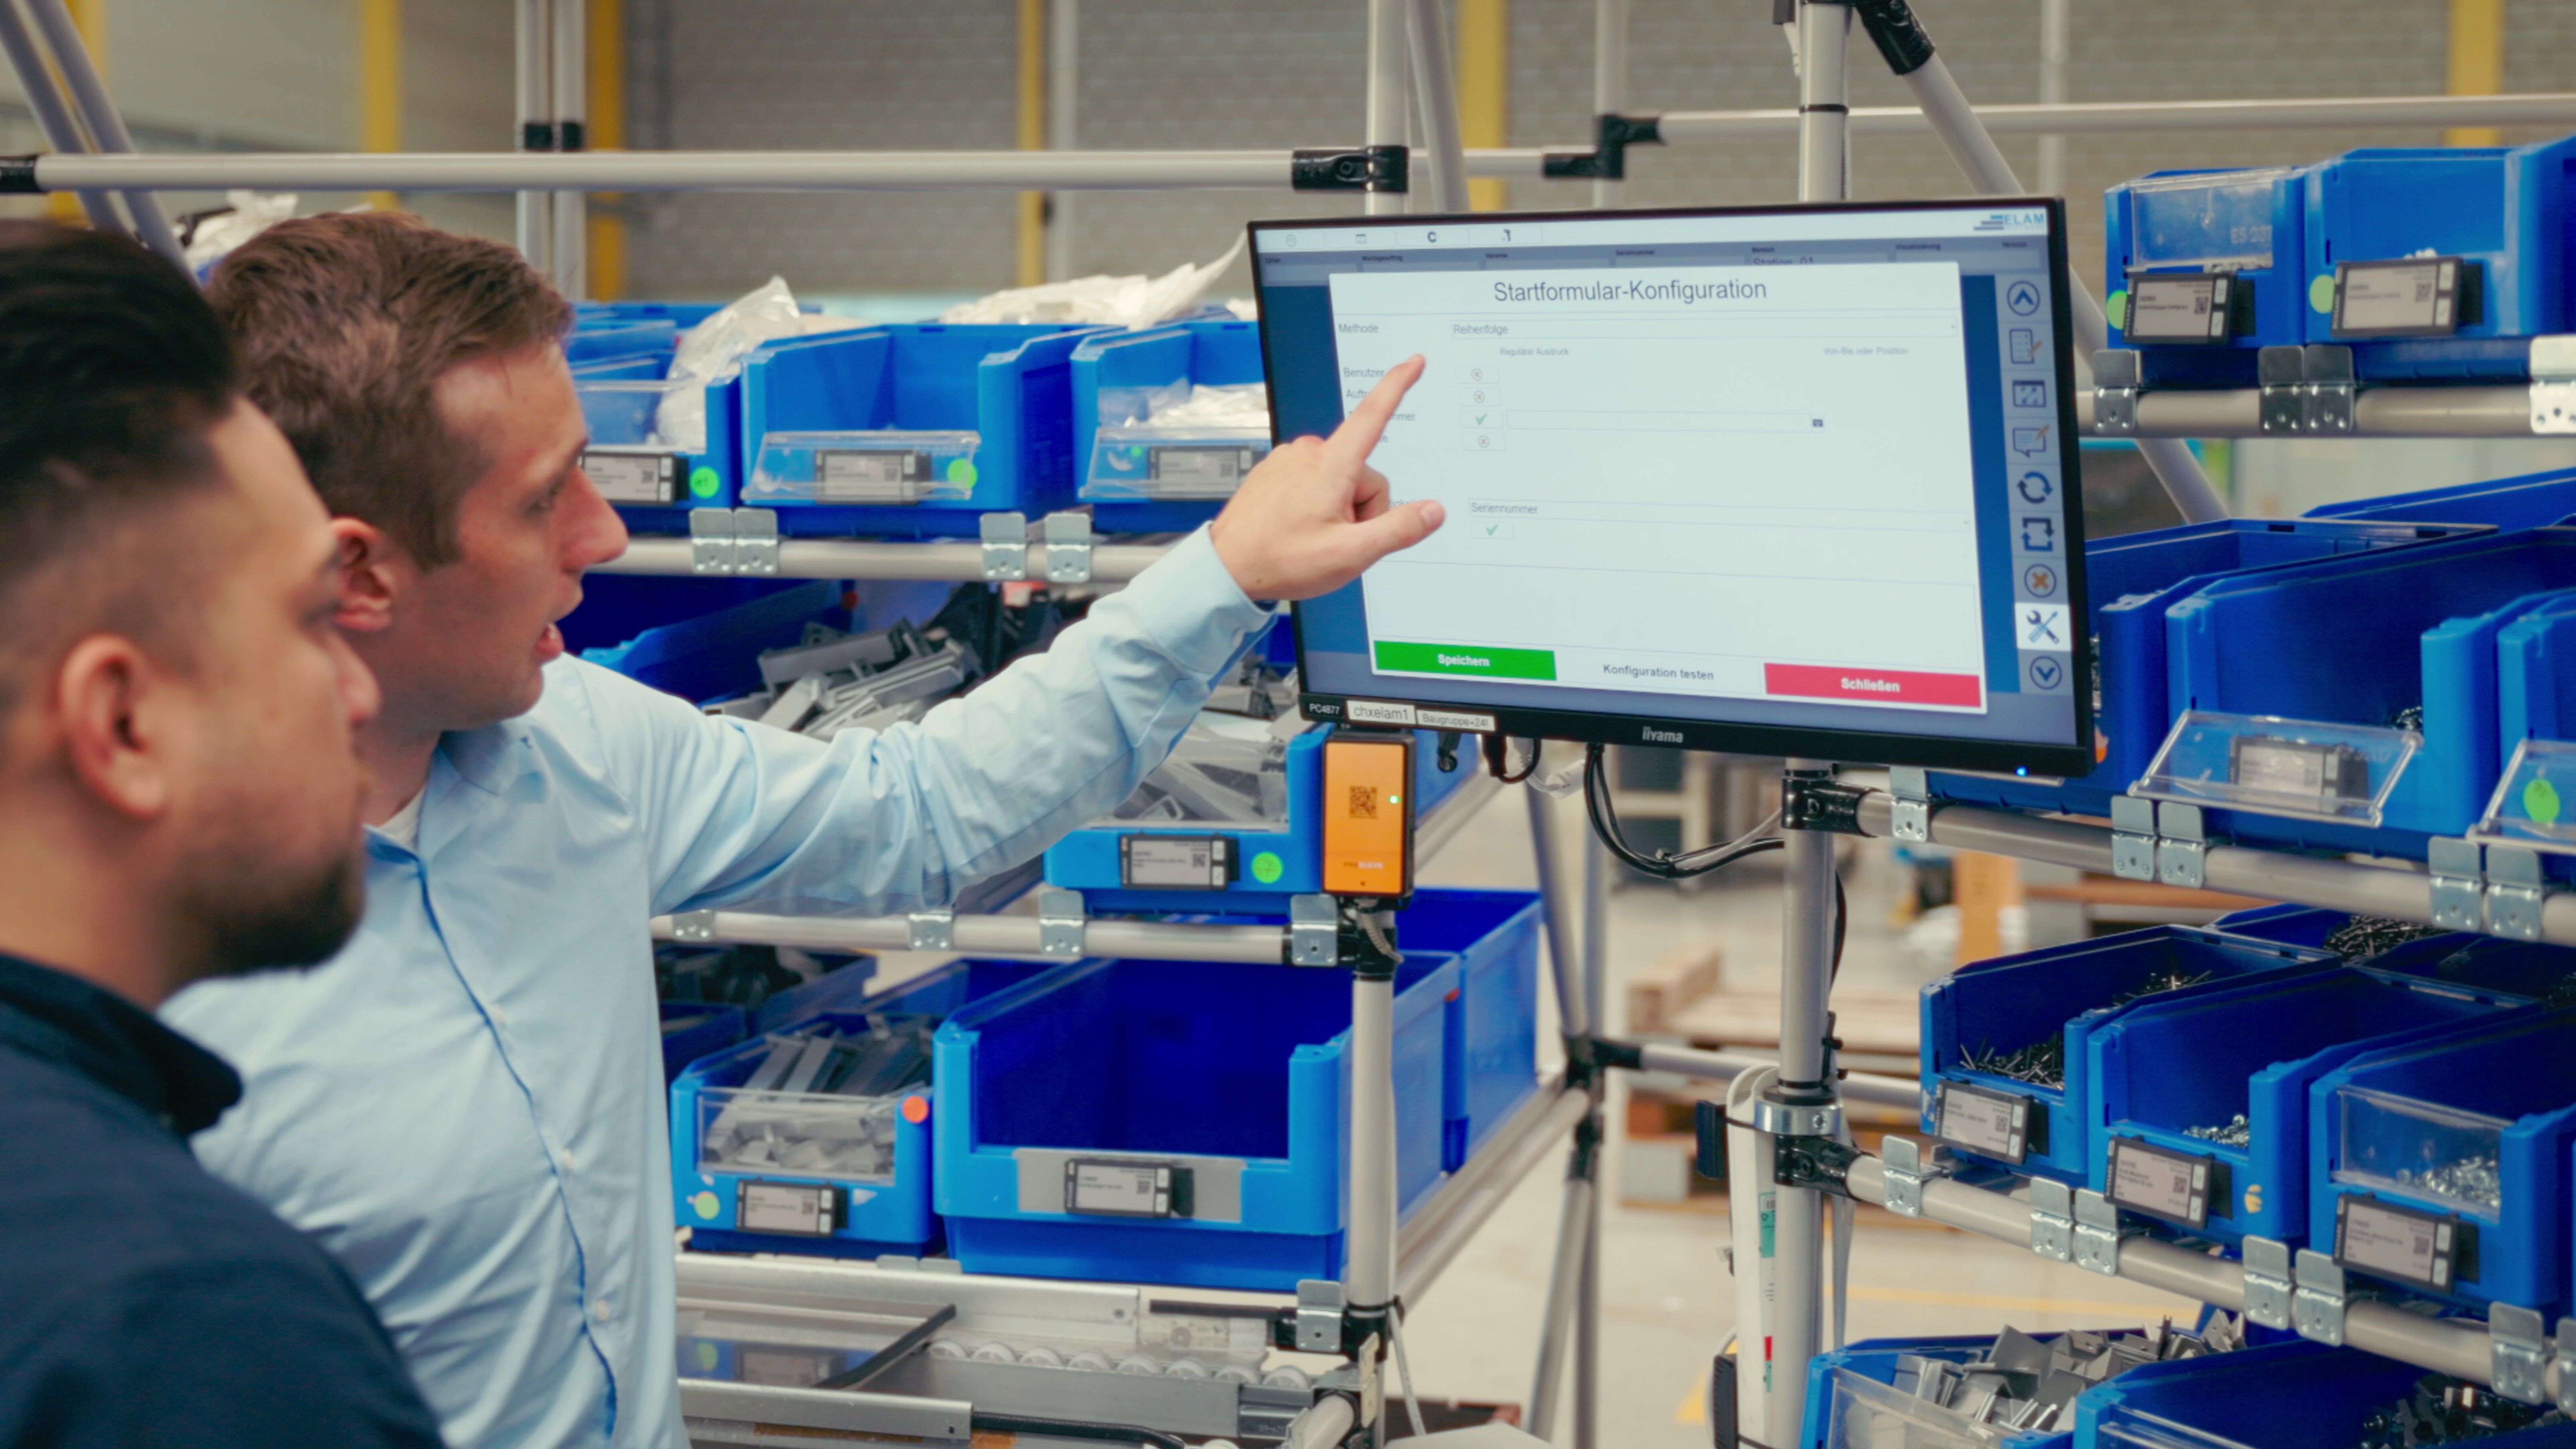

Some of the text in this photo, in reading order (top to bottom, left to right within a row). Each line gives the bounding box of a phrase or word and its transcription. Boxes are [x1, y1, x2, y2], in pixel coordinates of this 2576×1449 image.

[2004, 214, 2045, 225] ELAM
[1493, 278, 1768, 305] Startformular-Konfiguration
[1338, 323, 1379, 334] Methode
[1453, 324, 1509, 336] Reihenfolge
[1499, 347, 1534, 357] Regulärer
[1823, 346, 1854, 355] Von-Bis
[1876, 346, 1908, 355] Position
[1343, 367, 1384, 377] Benutzer
[1471, 501, 1539, 514] Seriennummer
[1437, 653, 1491, 668] Speichern
[1603, 663, 1714, 680] Konfiguration testen
[1840, 677, 1900, 693] Schließen
[1309, 703, 1340, 714] PC4877
[1642, 726, 1684, 743] iiyama
